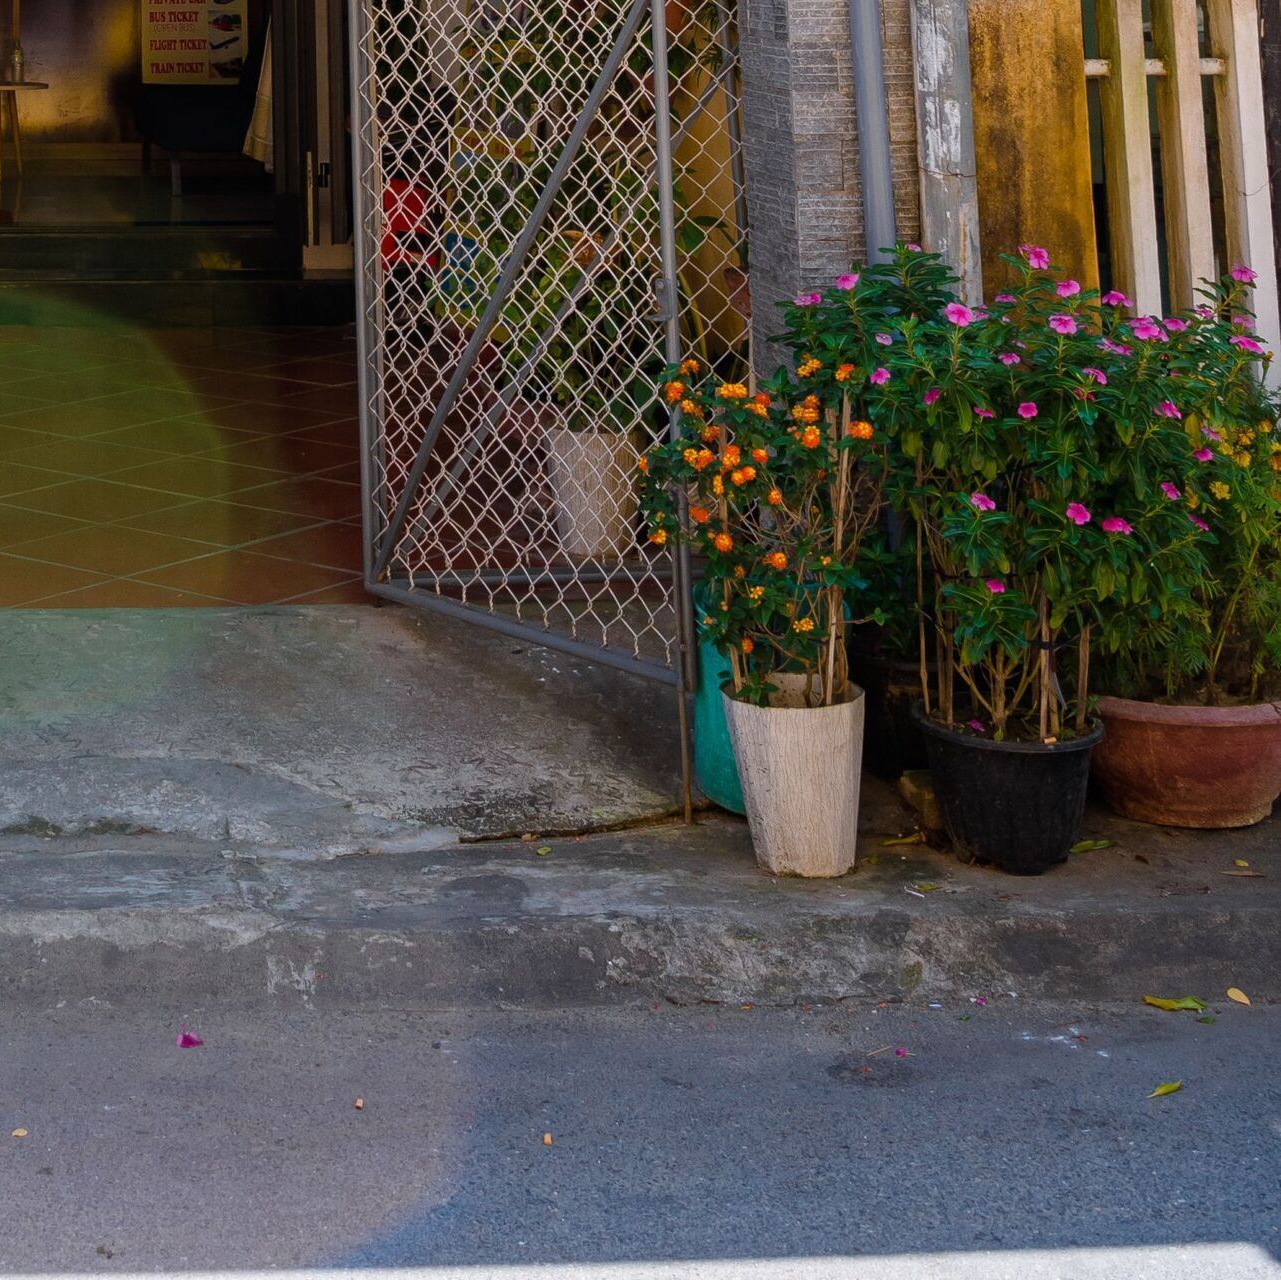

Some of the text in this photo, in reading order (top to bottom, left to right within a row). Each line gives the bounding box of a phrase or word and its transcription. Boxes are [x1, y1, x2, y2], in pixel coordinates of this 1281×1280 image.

[149, 11, 199, 23] BUS TICKET
[150, 39, 207, 51] FLIGHT TICKET
[150, 62, 205, 74] TRAIN TICKET
